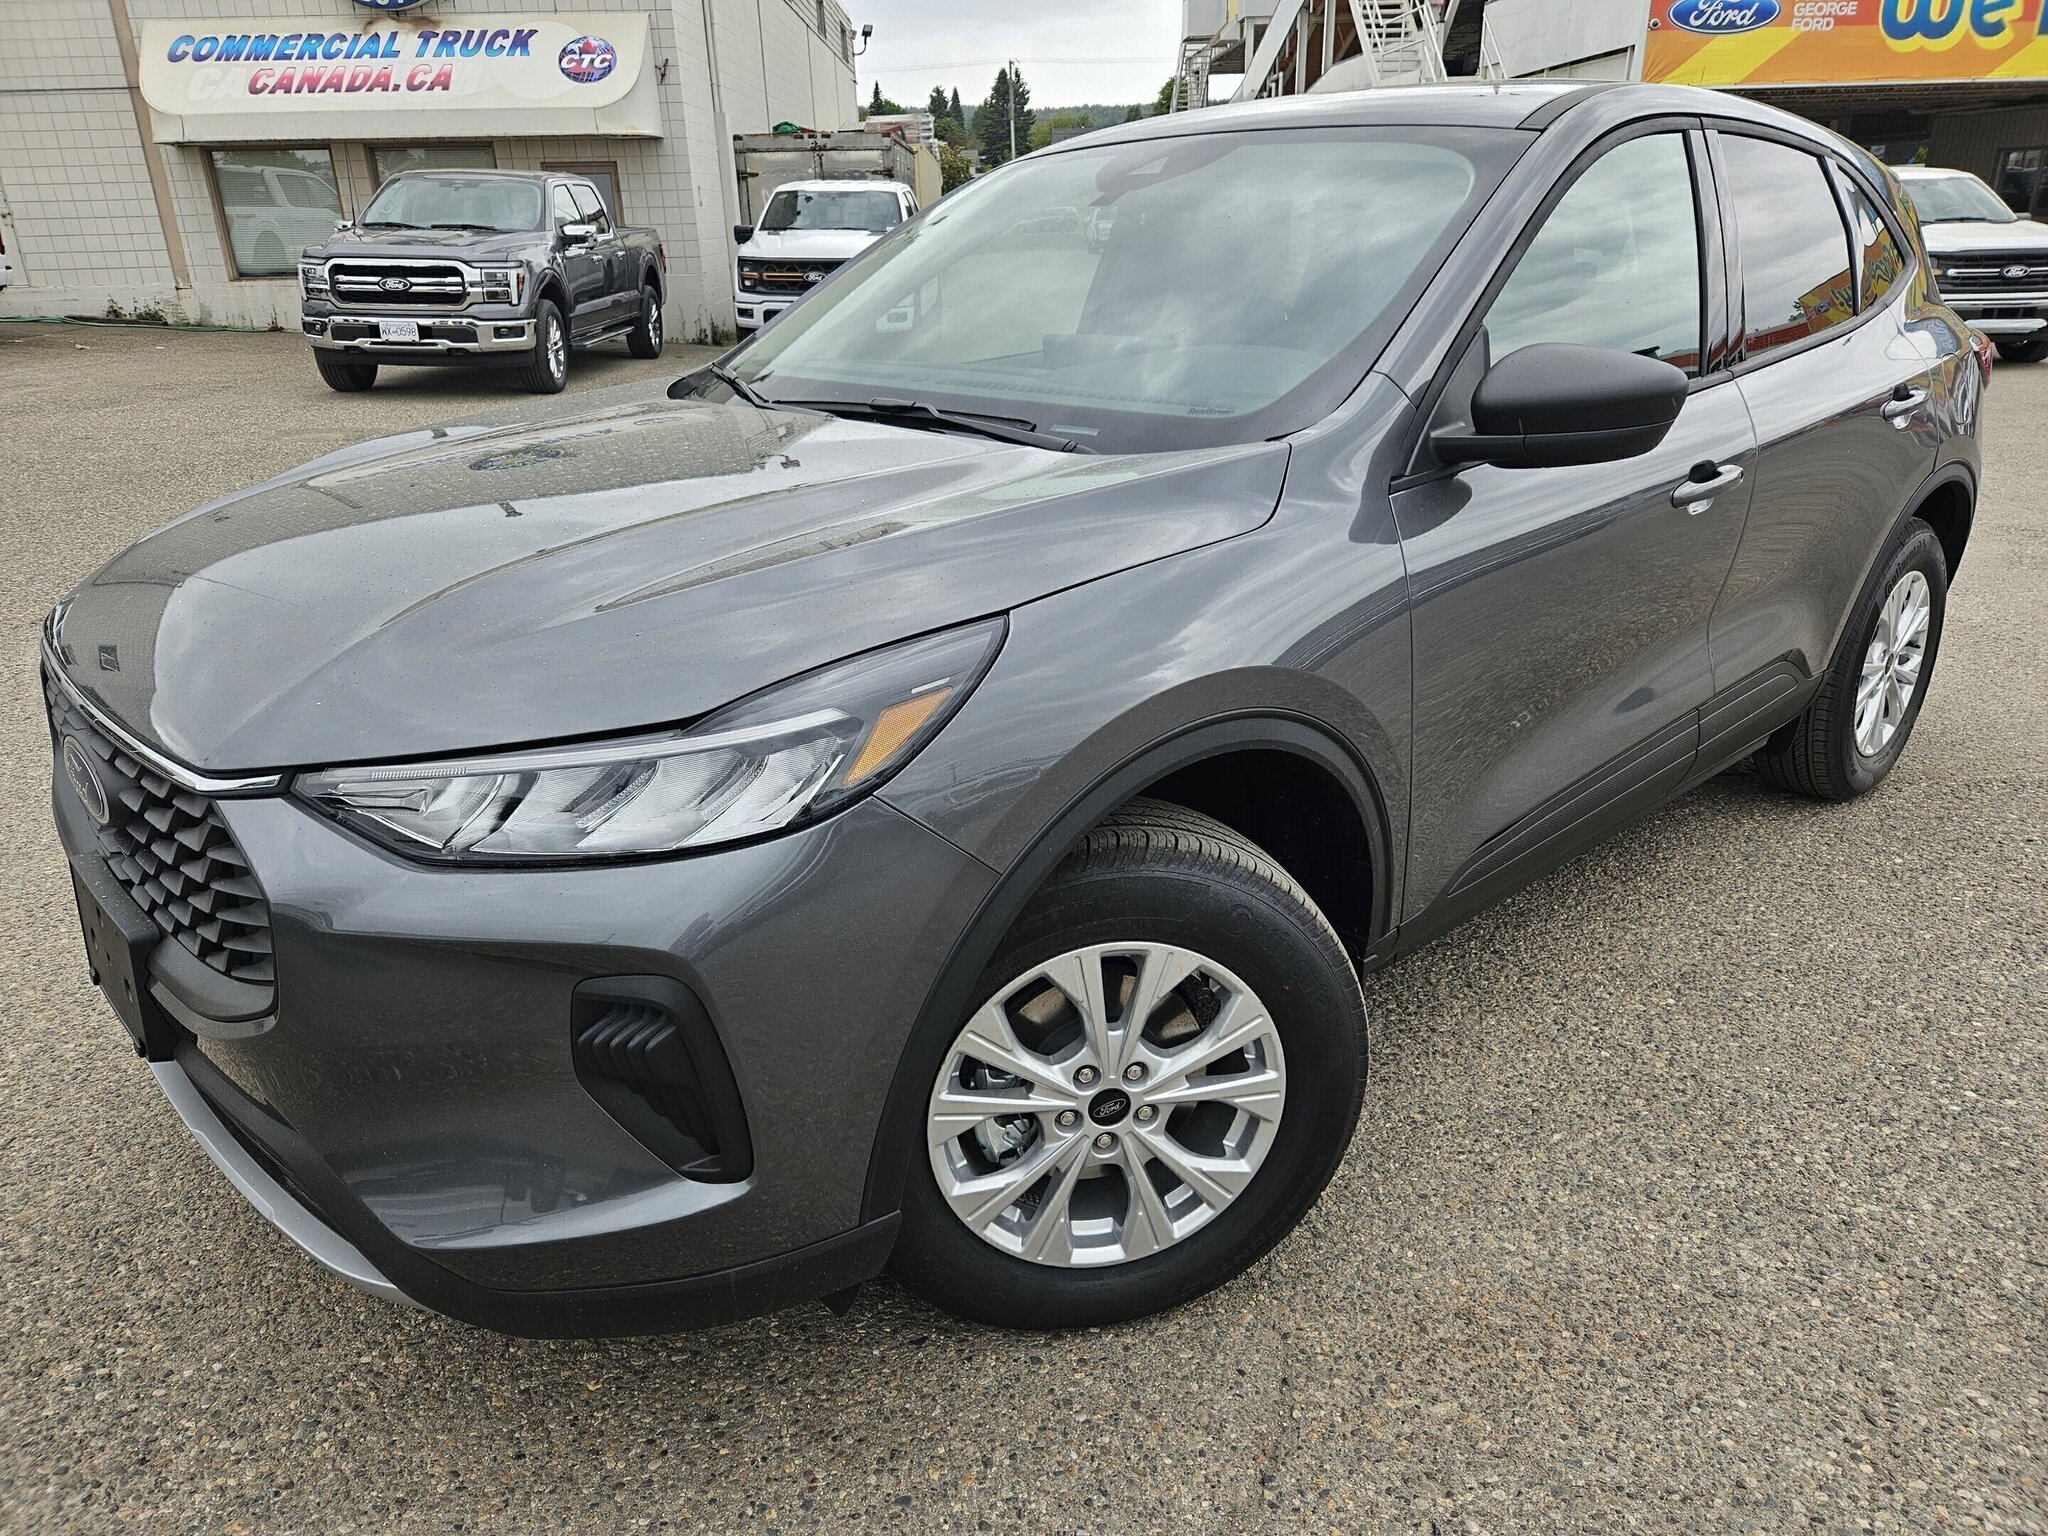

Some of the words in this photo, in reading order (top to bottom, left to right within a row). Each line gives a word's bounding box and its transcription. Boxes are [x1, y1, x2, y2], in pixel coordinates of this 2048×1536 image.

[1689, 0, 1756, 27] Ford
[1793, 1, 1857, 16] GEORGE
[1792, 17, 1834, 32] FORD
[167, 31, 400, 62] COMMERCIAL
[415, 29, 538, 58] TRUCK
[560, 53, 613, 70] CTC
[247, 64, 453, 95] CANADA.CA
[385, 280, 404, 288] Ford
[1100, 1102, 1120, 1115] Ford
